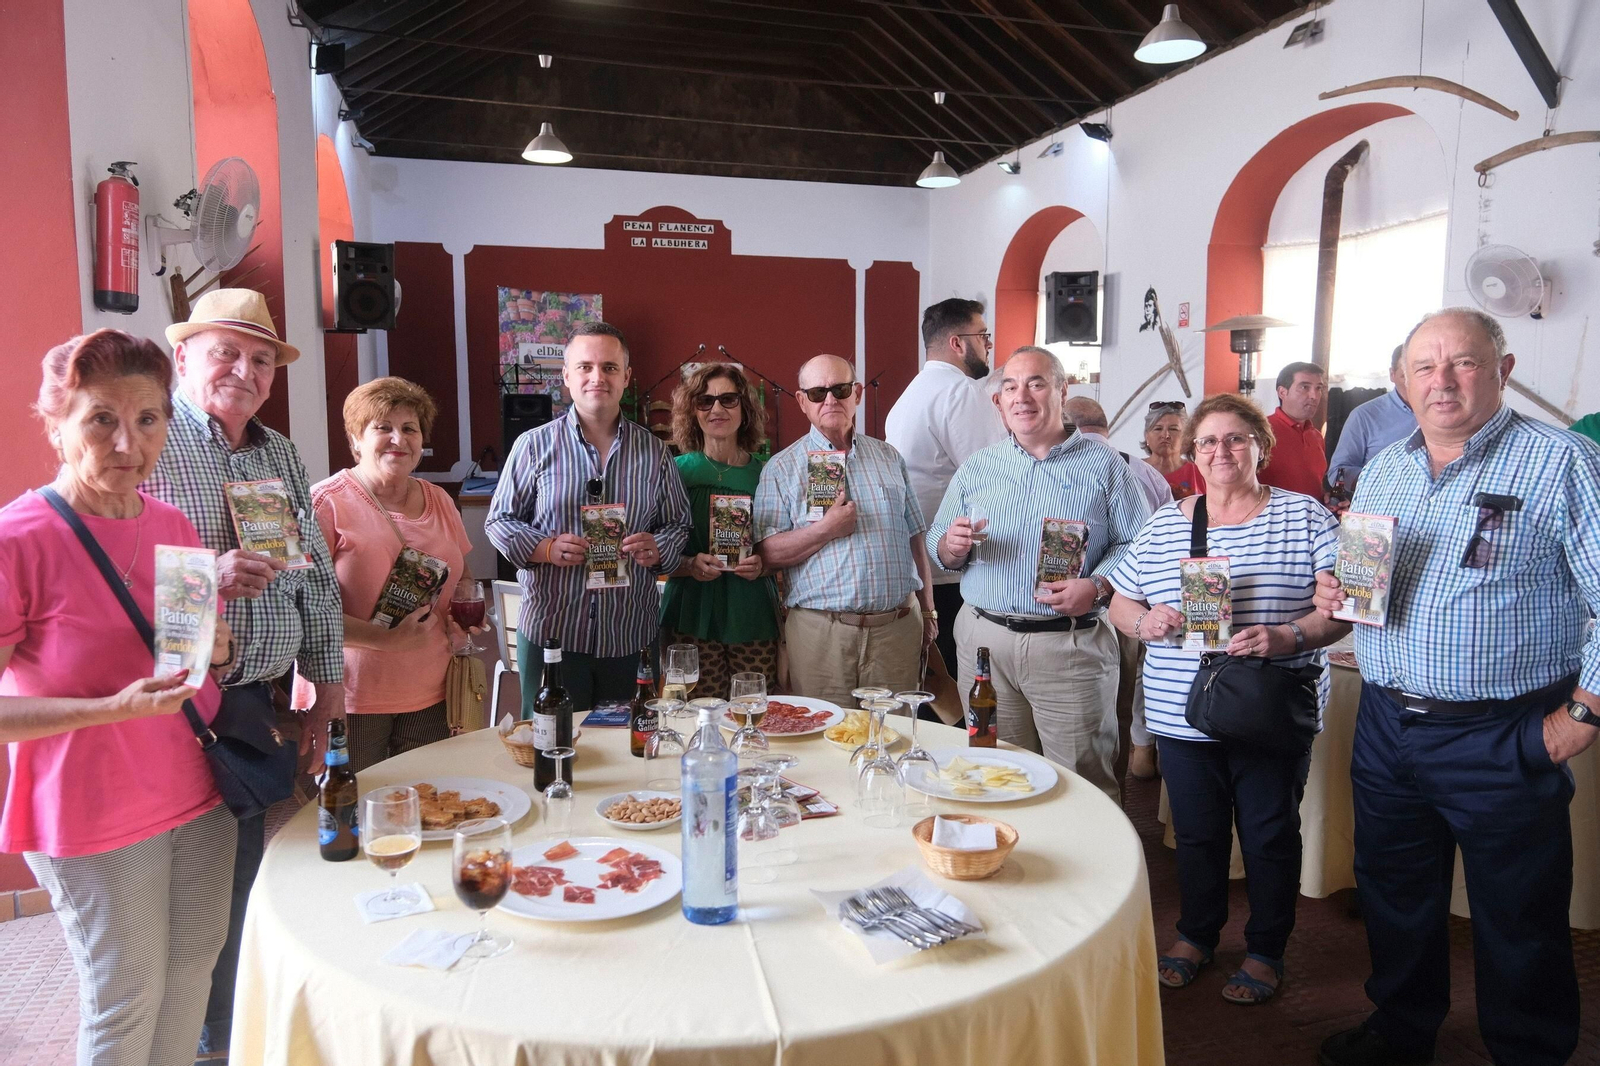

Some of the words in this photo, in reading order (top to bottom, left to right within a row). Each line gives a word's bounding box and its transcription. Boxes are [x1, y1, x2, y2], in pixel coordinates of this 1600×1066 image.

[624, 221, 652, 230] PEÑA
[632, 238, 645, 246] LA
[653, 239, 707, 248] ALBUHERA
[811, 482, 835, 491] Patios
[241, 519, 280, 532] Patios
[715, 528, 740, 538] Patios
[248, 539, 286, 550] Córdoba
[589, 542, 616, 554] Patios
[590, 561, 618, 570] Córdoba
[1043, 554, 1069, 566] Patios
[1341, 559, 1374, 576] Patios
[388, 582, 419, 603] Patios
[1344, 585, 1372, 599] órdoba
[1186, 599, 1218, 611] Patios
[161, 606, 199, 626] Patios
[1187, 620, 1219, 631] Córdoba
